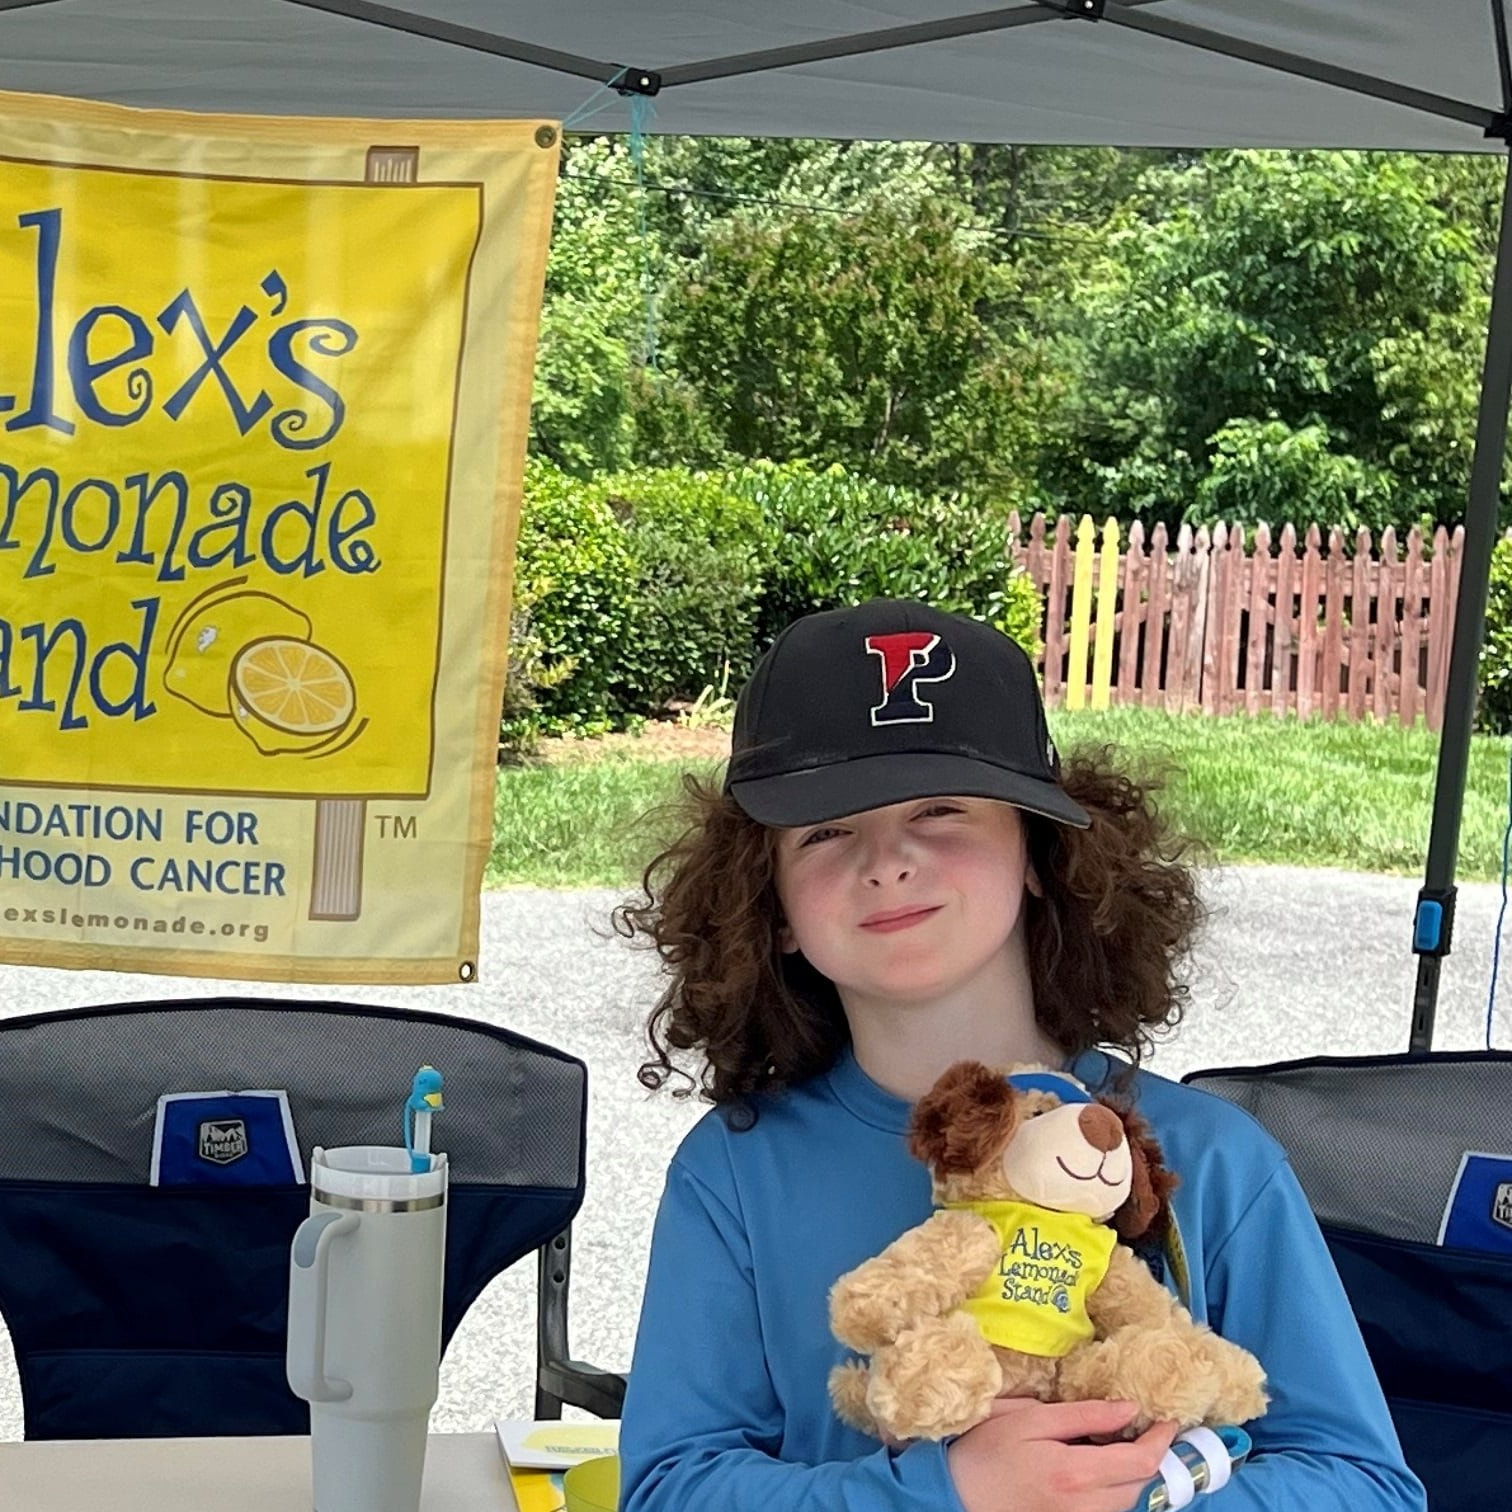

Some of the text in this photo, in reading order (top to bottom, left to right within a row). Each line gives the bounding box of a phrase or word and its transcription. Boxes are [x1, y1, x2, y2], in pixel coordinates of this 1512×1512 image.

[866, 631, 956, 727] P
[185, 811, 259, 846] FOR
[374, 814, 418, 840] TM
[131, 857, 287, 897] CANCER
[998, 1253, 1079, 1287] Lemonad
